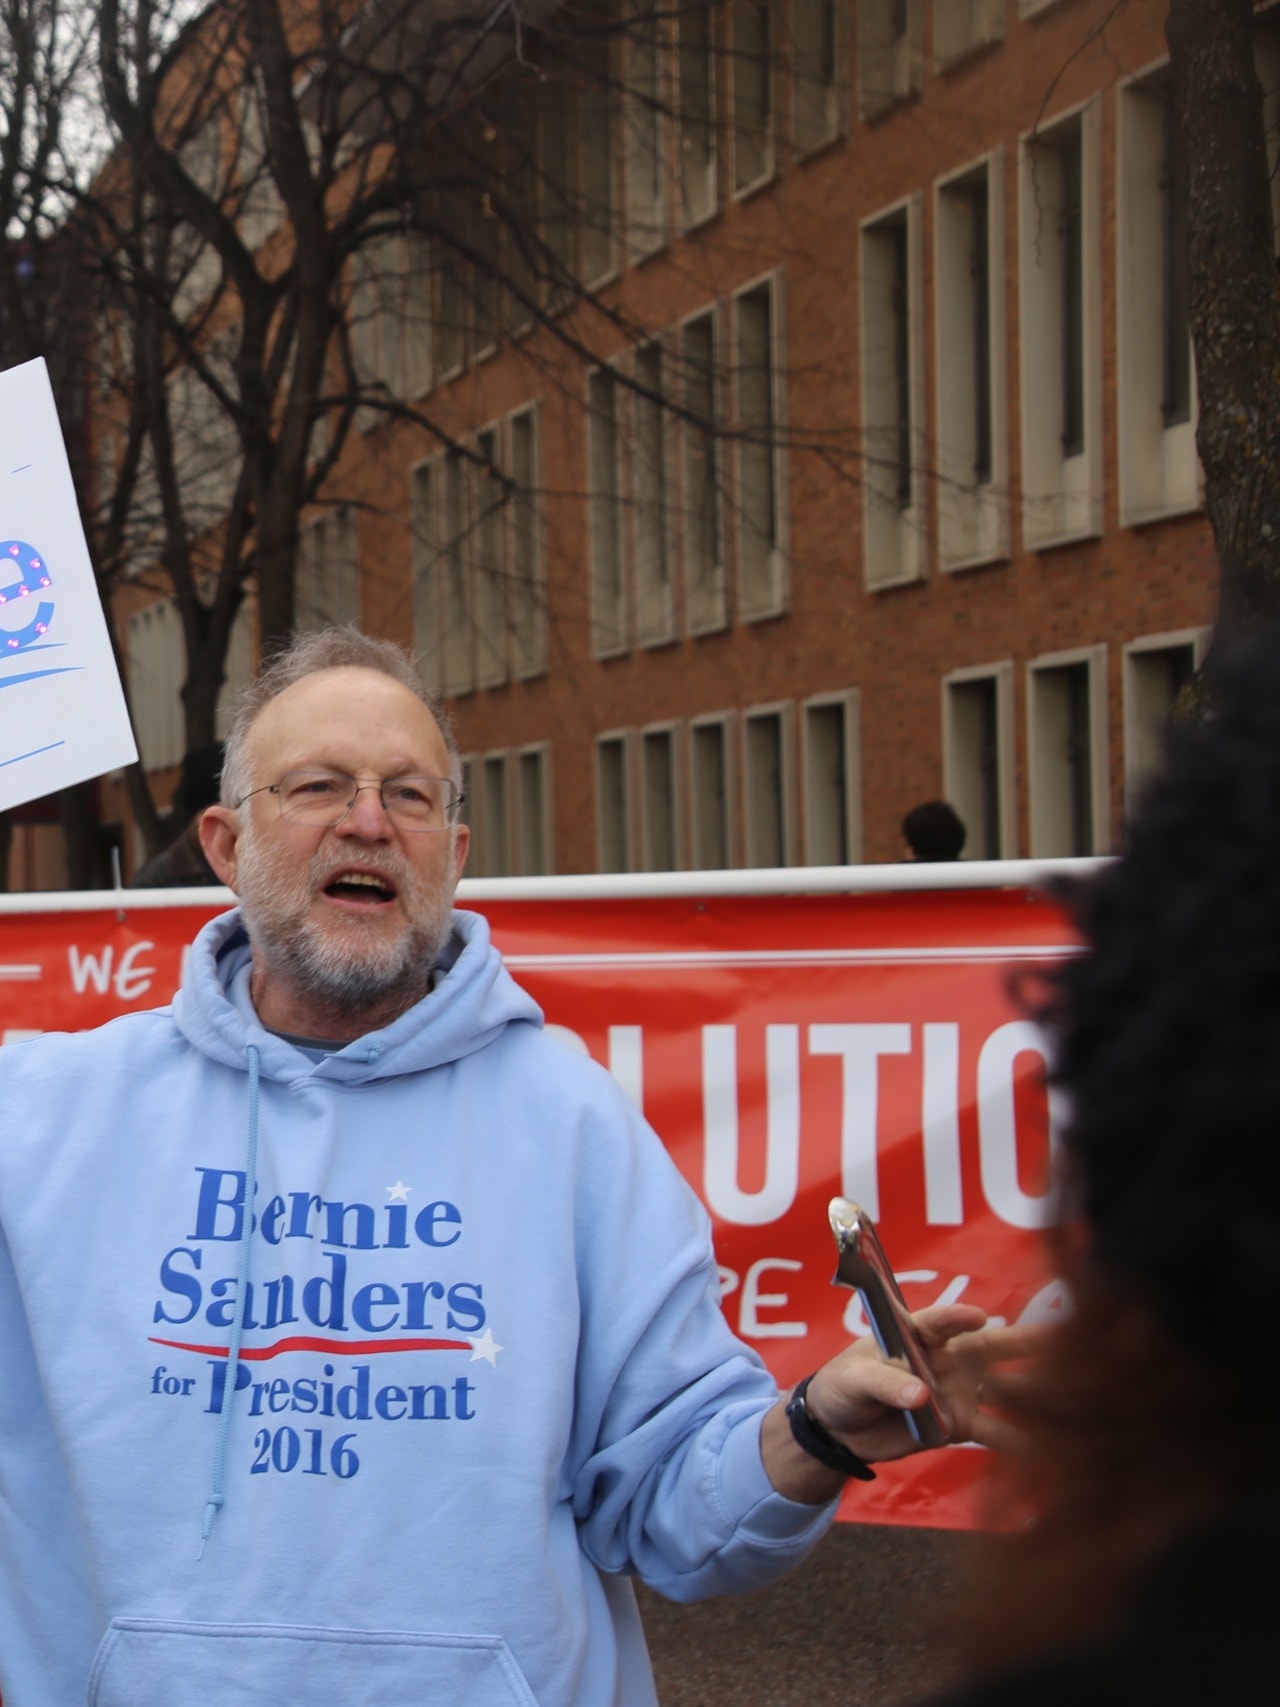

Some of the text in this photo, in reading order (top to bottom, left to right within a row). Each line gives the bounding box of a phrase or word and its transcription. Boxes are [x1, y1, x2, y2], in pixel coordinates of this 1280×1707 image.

[67, 941, 156, 1000] WE
[186, 1166, 463, 1250] Bernie
[152, 1247, 487, 1333] Sanders
[150, 1359, 477, 1421] for President
[249, 1425, 360, 1480] 2016
